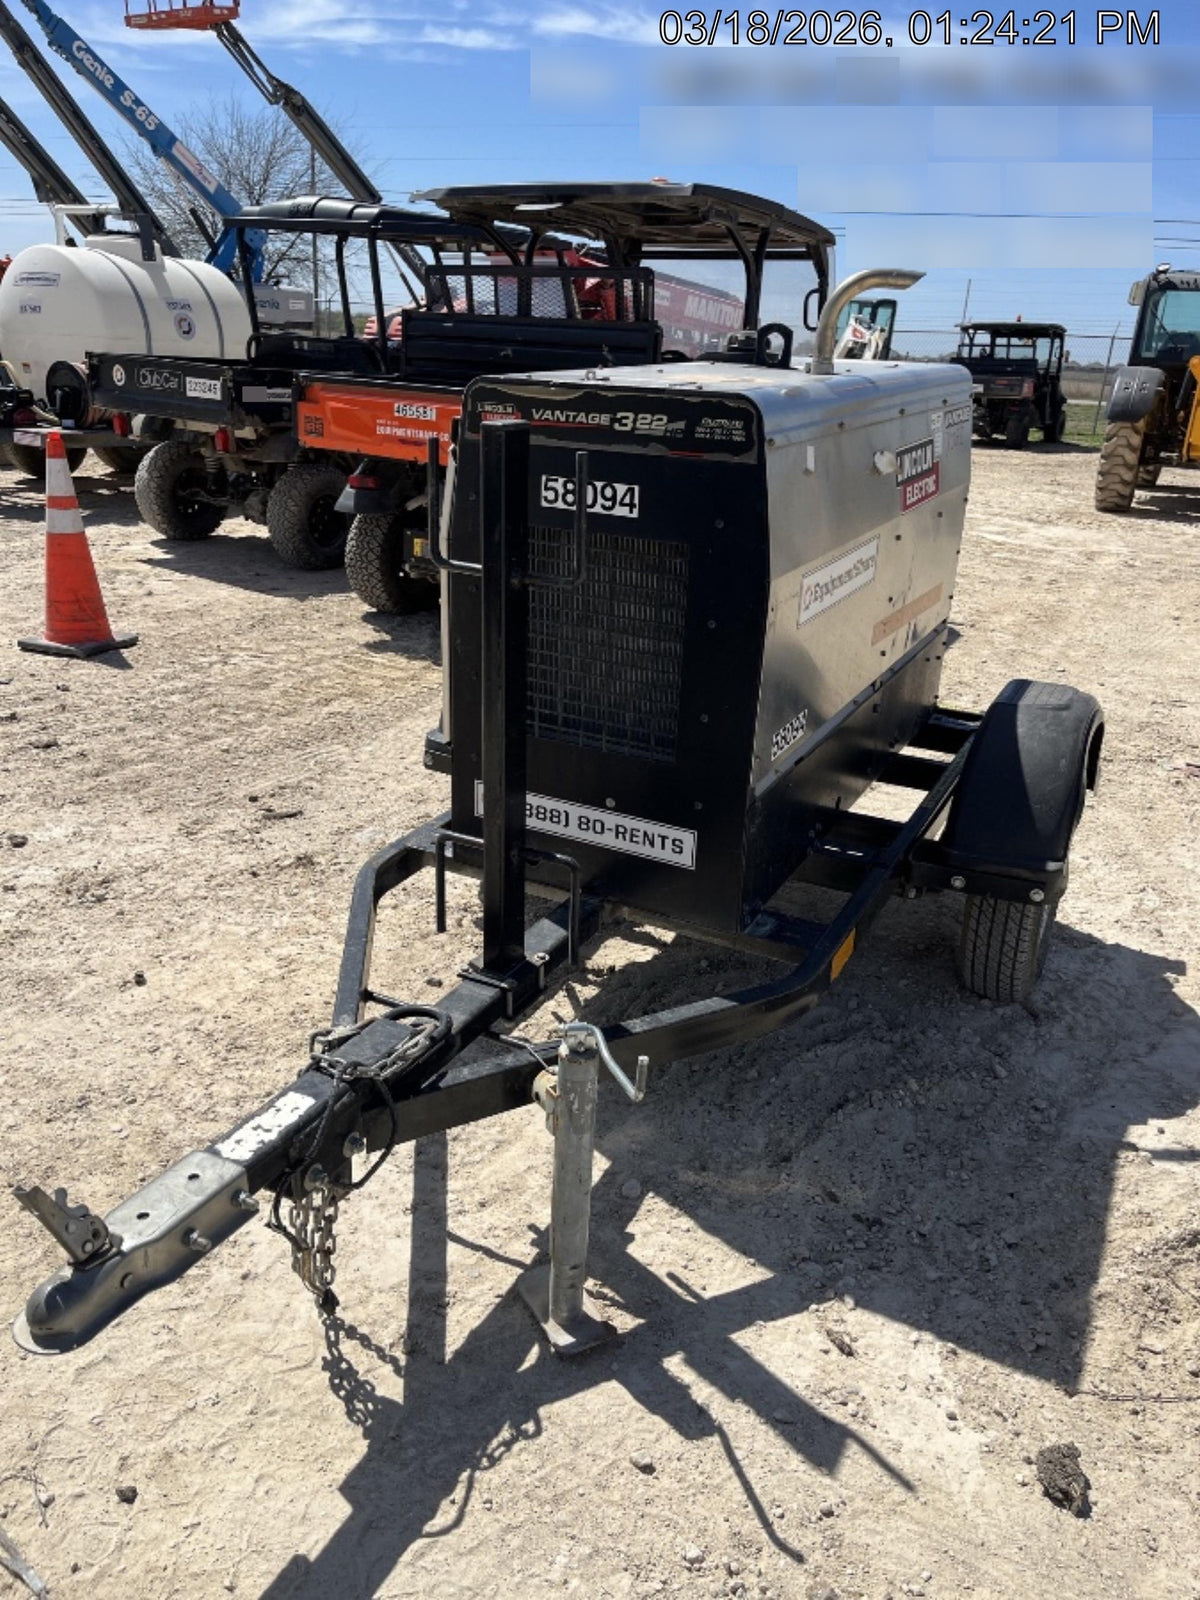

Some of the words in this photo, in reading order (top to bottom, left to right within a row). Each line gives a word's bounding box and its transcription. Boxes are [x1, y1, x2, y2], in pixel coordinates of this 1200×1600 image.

[72, 40, 115, 90] Genie
[120, 90, 160, 131] S-65
[684, 294, 744, 329] MANITOU
[531, 408, 611, 425] VANTAGE
[613, 411, 668, 431] 322
[542, 474, 637, 514] 58094
[906, 474, 937, 506] ELECTRIC
[526, 803, 569, 828] 888)
[578, 815, 684, 855] 80-RENTS
